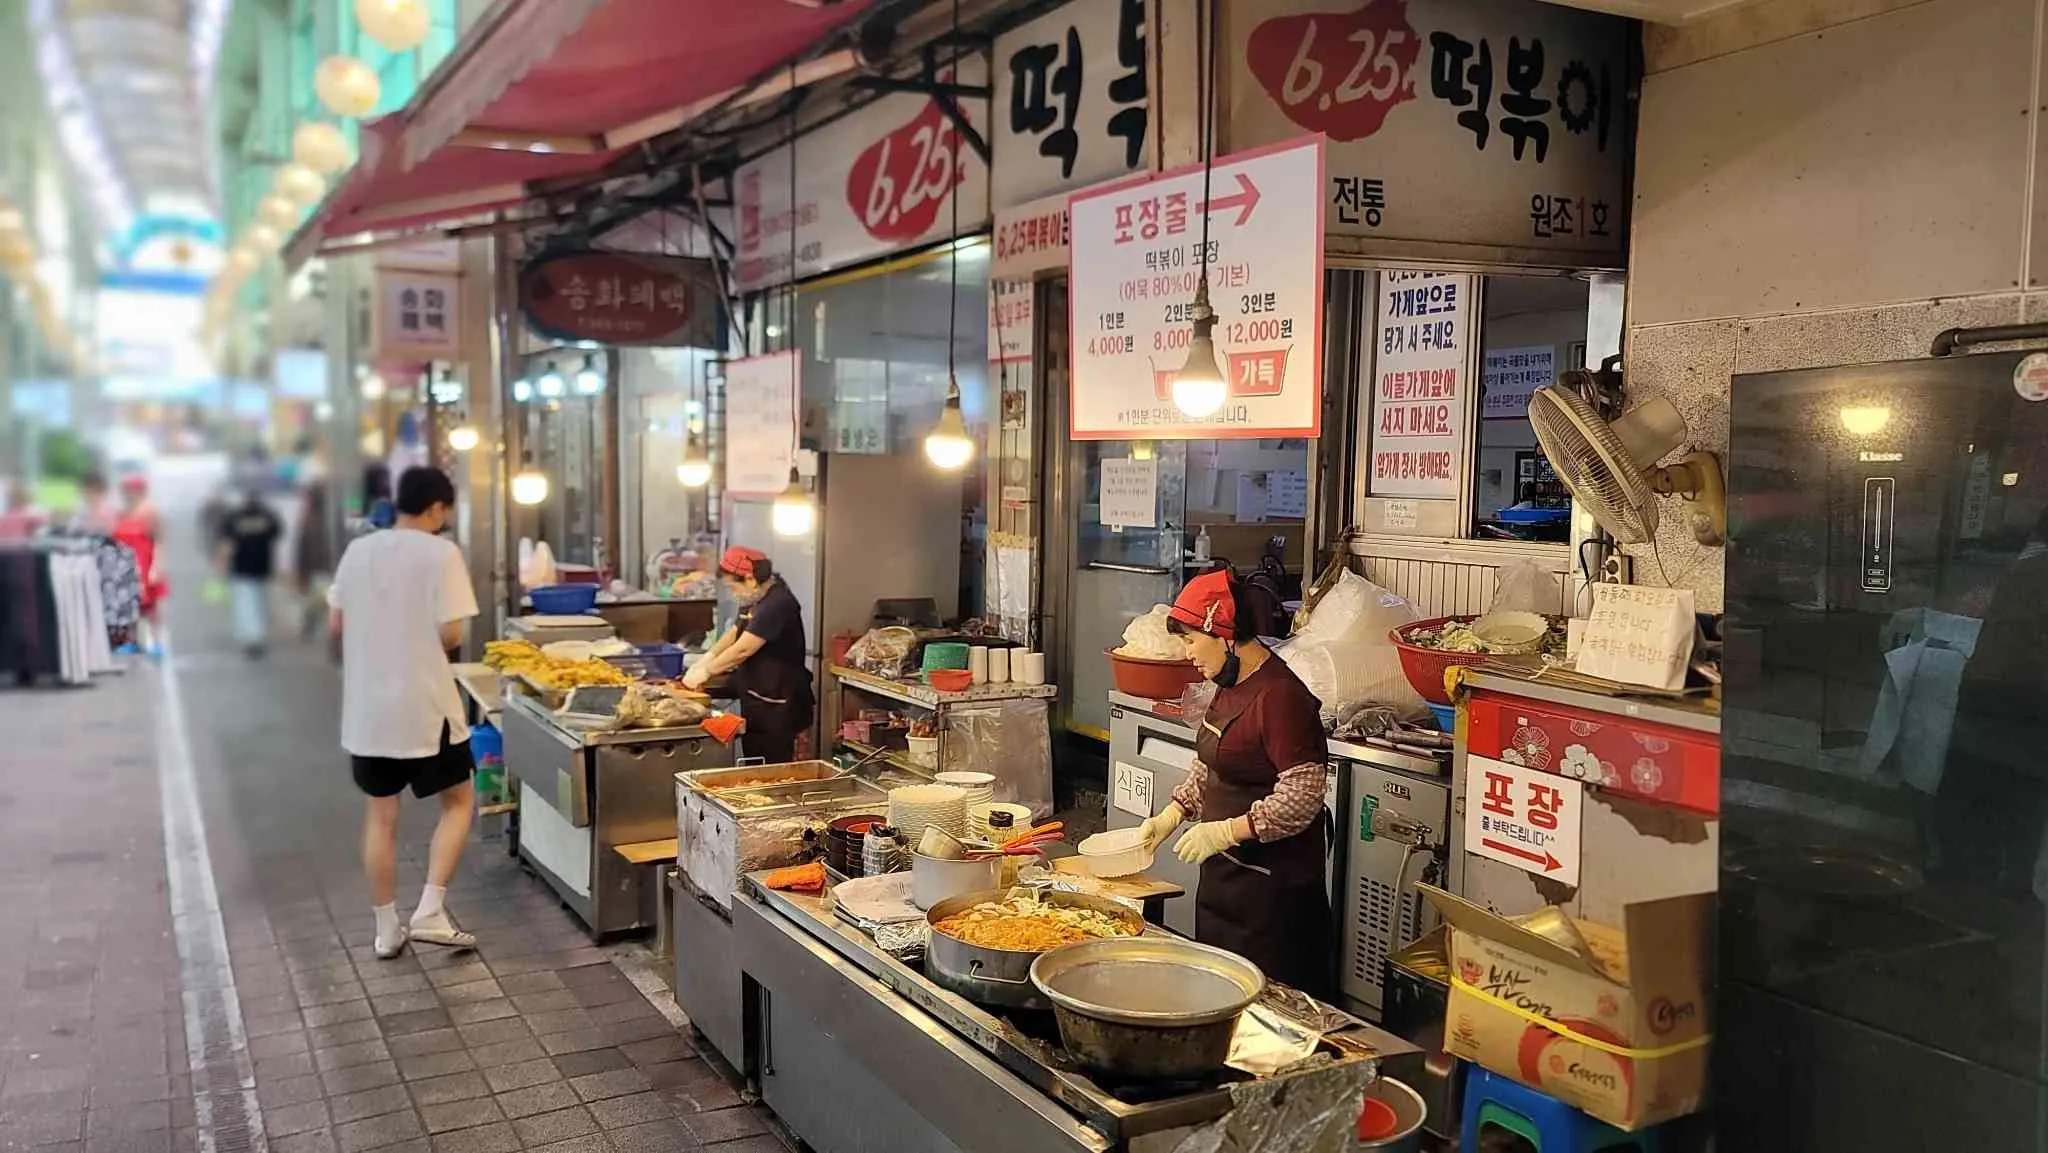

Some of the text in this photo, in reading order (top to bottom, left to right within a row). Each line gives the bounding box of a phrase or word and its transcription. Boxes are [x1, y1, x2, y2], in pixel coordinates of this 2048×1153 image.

[1282, 19, 1609, 164] 6.25 떡볶이
[866, 123, 953, 231] 6.25
[1333, 176, 1385, 227] 전통
[1114, 191, 1188, 245] 포장줄
[1145, 247, 1184, 272] 떡볶이
[1119, 279, 1149, 302] (어묵
[1216, 263, 1251, 289] 기본)
[1241, 292, 1276, 314] 3인분
[1389, 284, 1456, 318] 가게앞으로
[1099, 312, 1125, 331] 1인분
[1226, 319, 1293, 344] 12,000원
[1088, 335, 1134, 357] 4,000원
[1240, 358, 1275, 386] 가득
[1382, 368, 1456, 399] 이불가게앞에
[1381, 407, 1405, 433] 서지
[1119, 769, 1151, 808] 식혜
